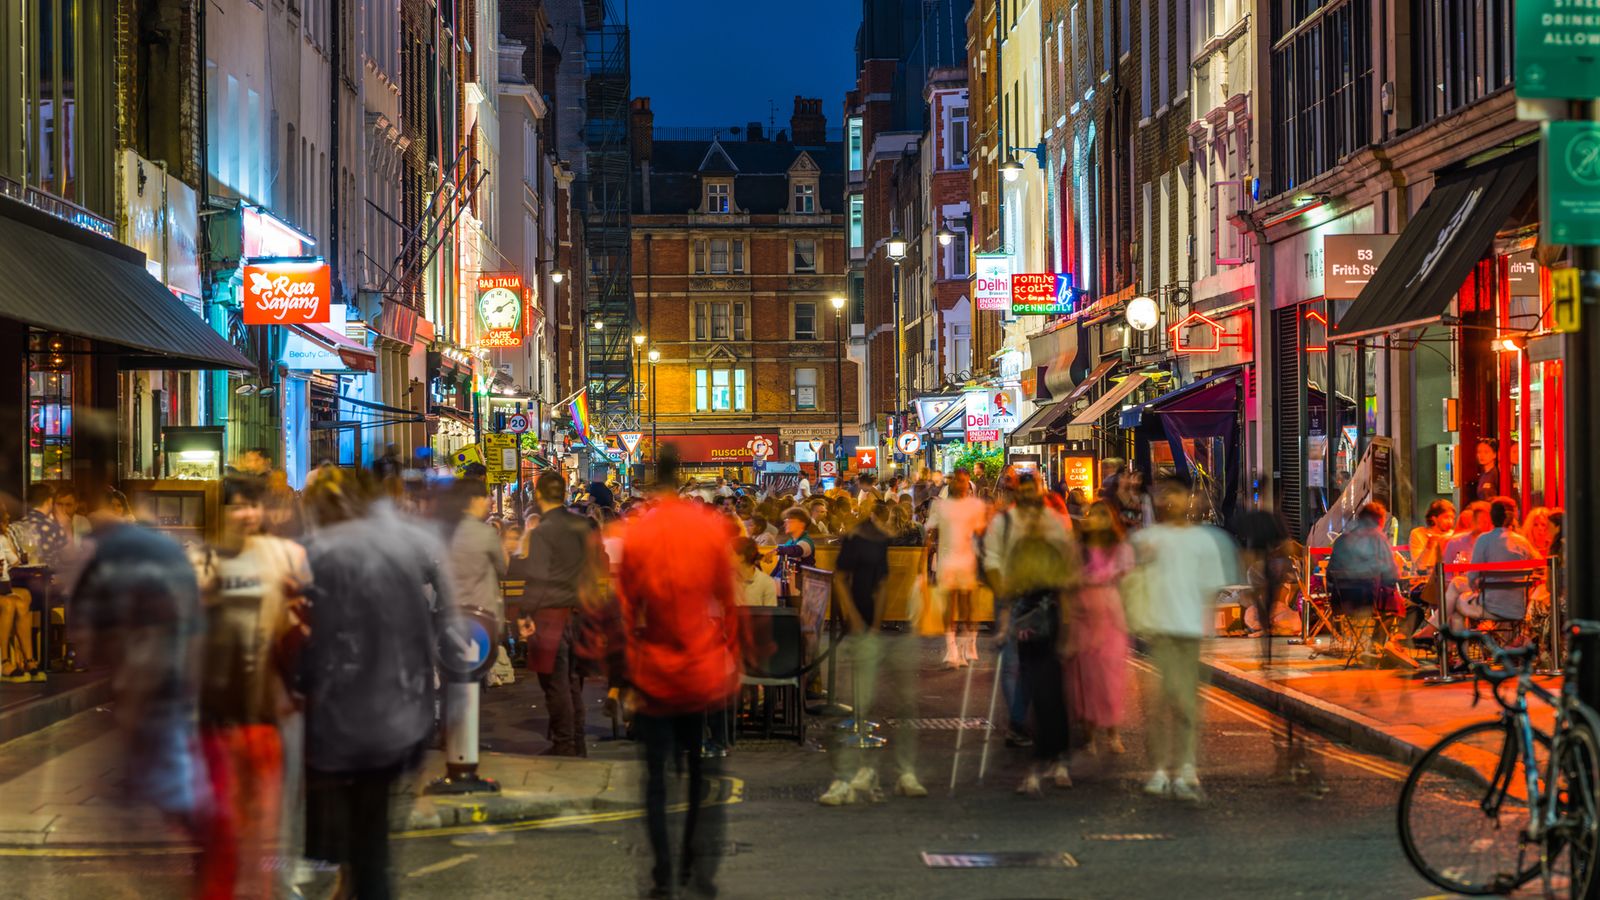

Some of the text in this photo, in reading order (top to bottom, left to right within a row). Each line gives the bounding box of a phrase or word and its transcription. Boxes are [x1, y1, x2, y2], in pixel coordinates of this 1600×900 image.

[1357, 249, 1373, 260] 53
[1332, 264, 1378, 276] Frith St
[479, 278, 520, 288] BAR ITALIA
[1013, 274, 1054, 284] ronnie
[272, 275, 315, 297] Rasa
[978, 279, 1008, 291] Delhi
[256, 290, 320, 320] Sayang
[289, 350, 317, 359] Beauty
[511, 418, 526, 428] 20
[711, 447, 752, 456] nusadu
